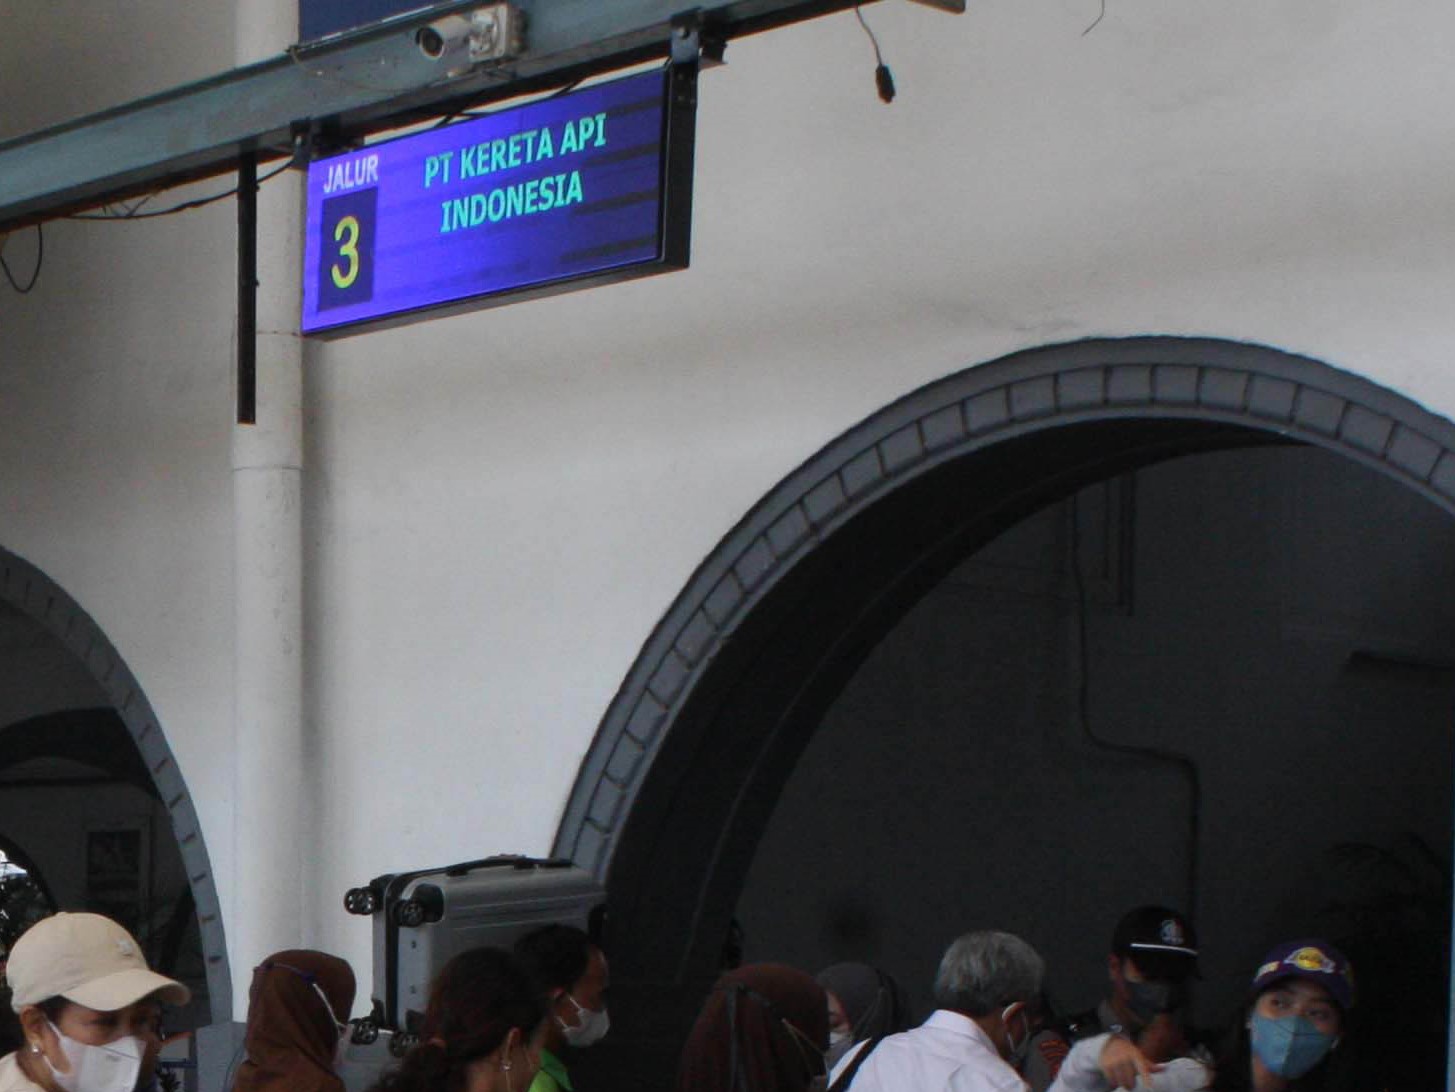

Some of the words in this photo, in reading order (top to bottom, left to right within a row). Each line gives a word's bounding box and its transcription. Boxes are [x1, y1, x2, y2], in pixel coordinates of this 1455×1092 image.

[322, 154, 379, 194] JALUR
[425, 151, 453, 187] PT
[460, 126, 554, 180] KERETA
[561, 113, 607, 155] API
[439, 169, 584, 233] INDONESIA
[331, 216, 359, 289] 3
